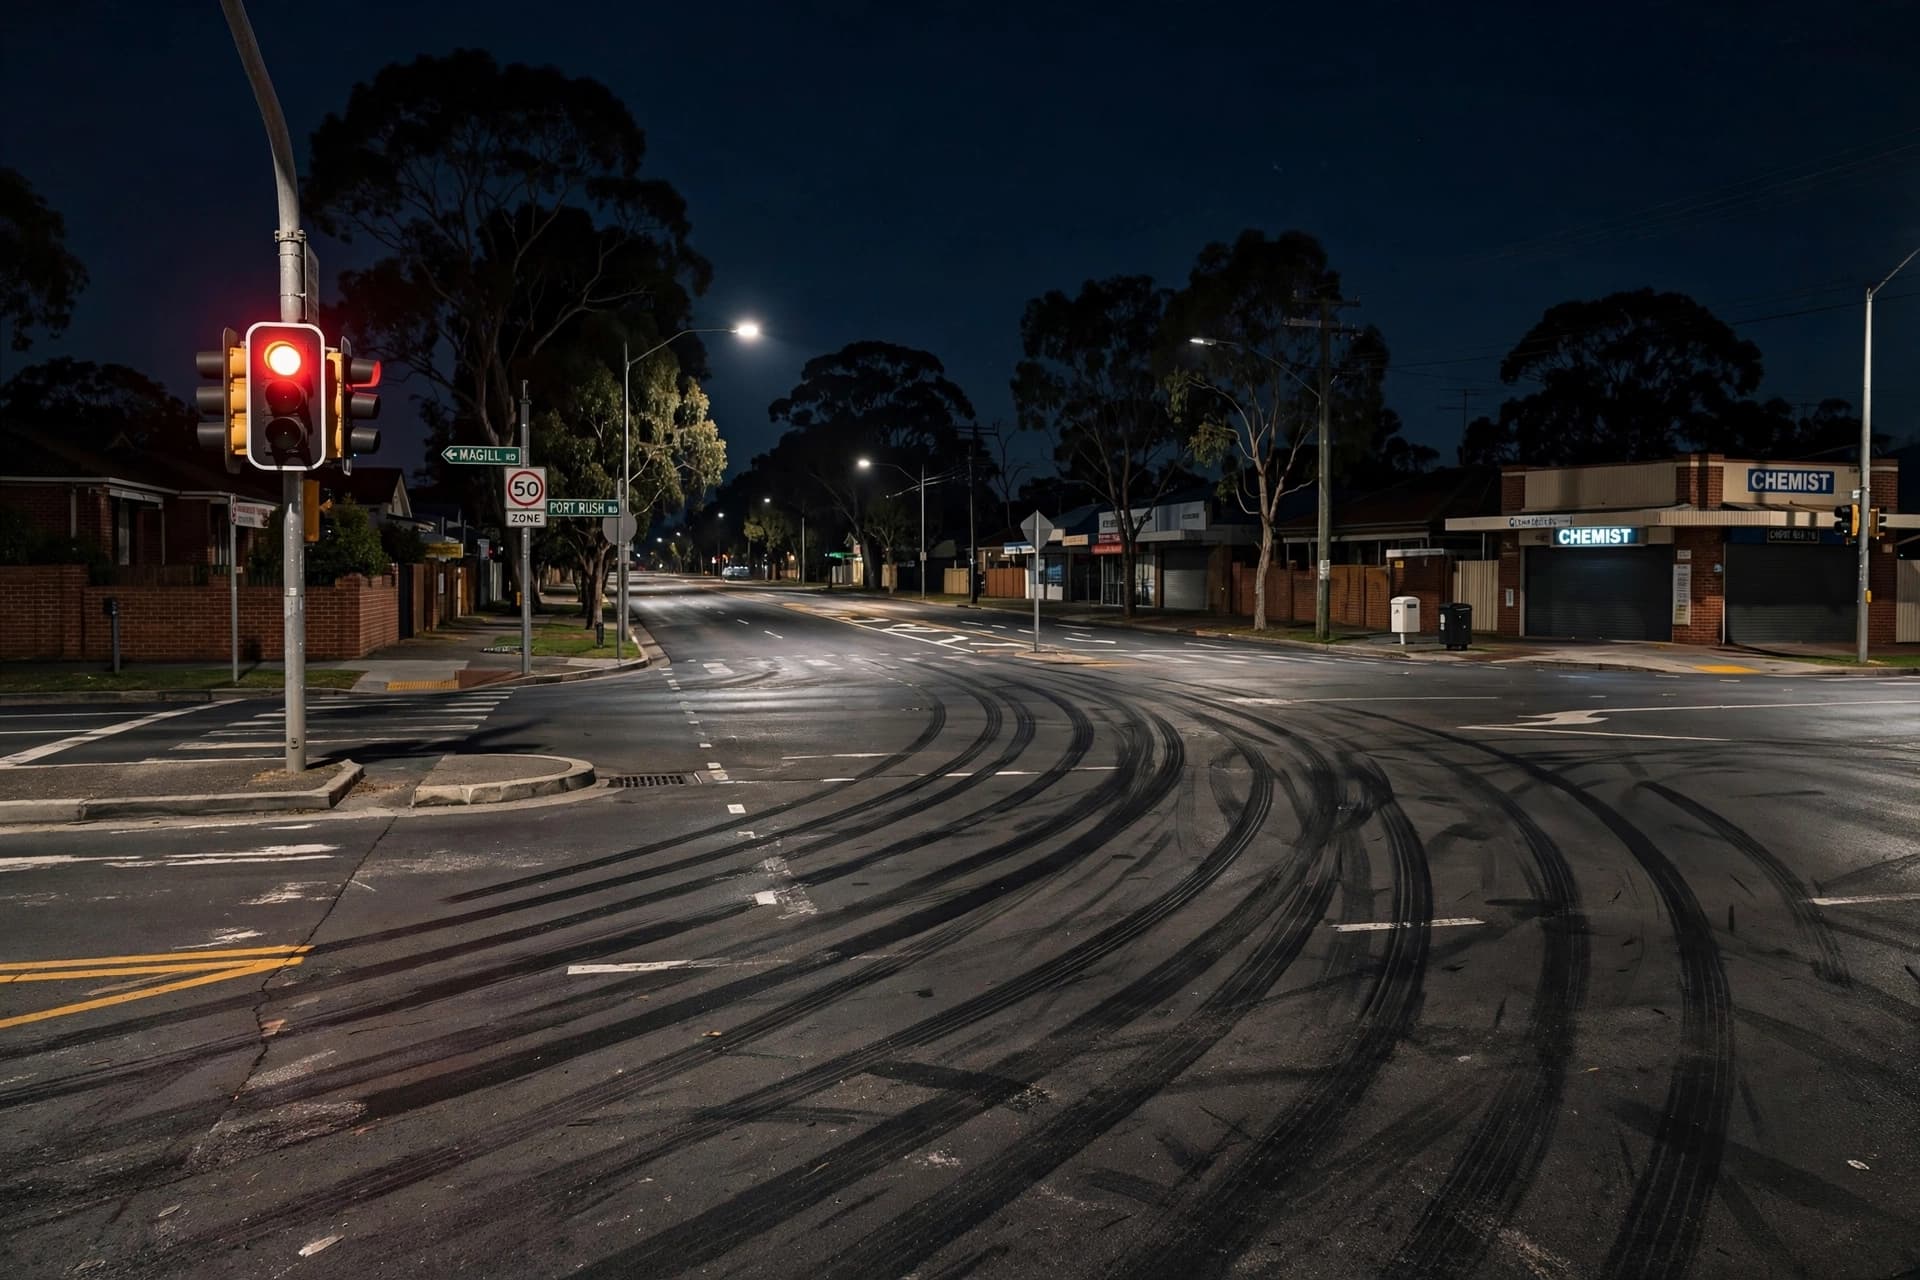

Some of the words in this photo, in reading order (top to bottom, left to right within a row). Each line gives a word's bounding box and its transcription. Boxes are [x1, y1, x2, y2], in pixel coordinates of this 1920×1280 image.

[459, 449, 501, 461] MAGILL
[514, 481, 539, 497] 50
[1751, 472, 1831, 492] CHEMIST
[550, 502, 575, 514] PORT
[579, 502, 605, 514] RUSH
[511, 513, 541, 523] ZONE
[1558, 527, 1633, 545] CHEMIST
